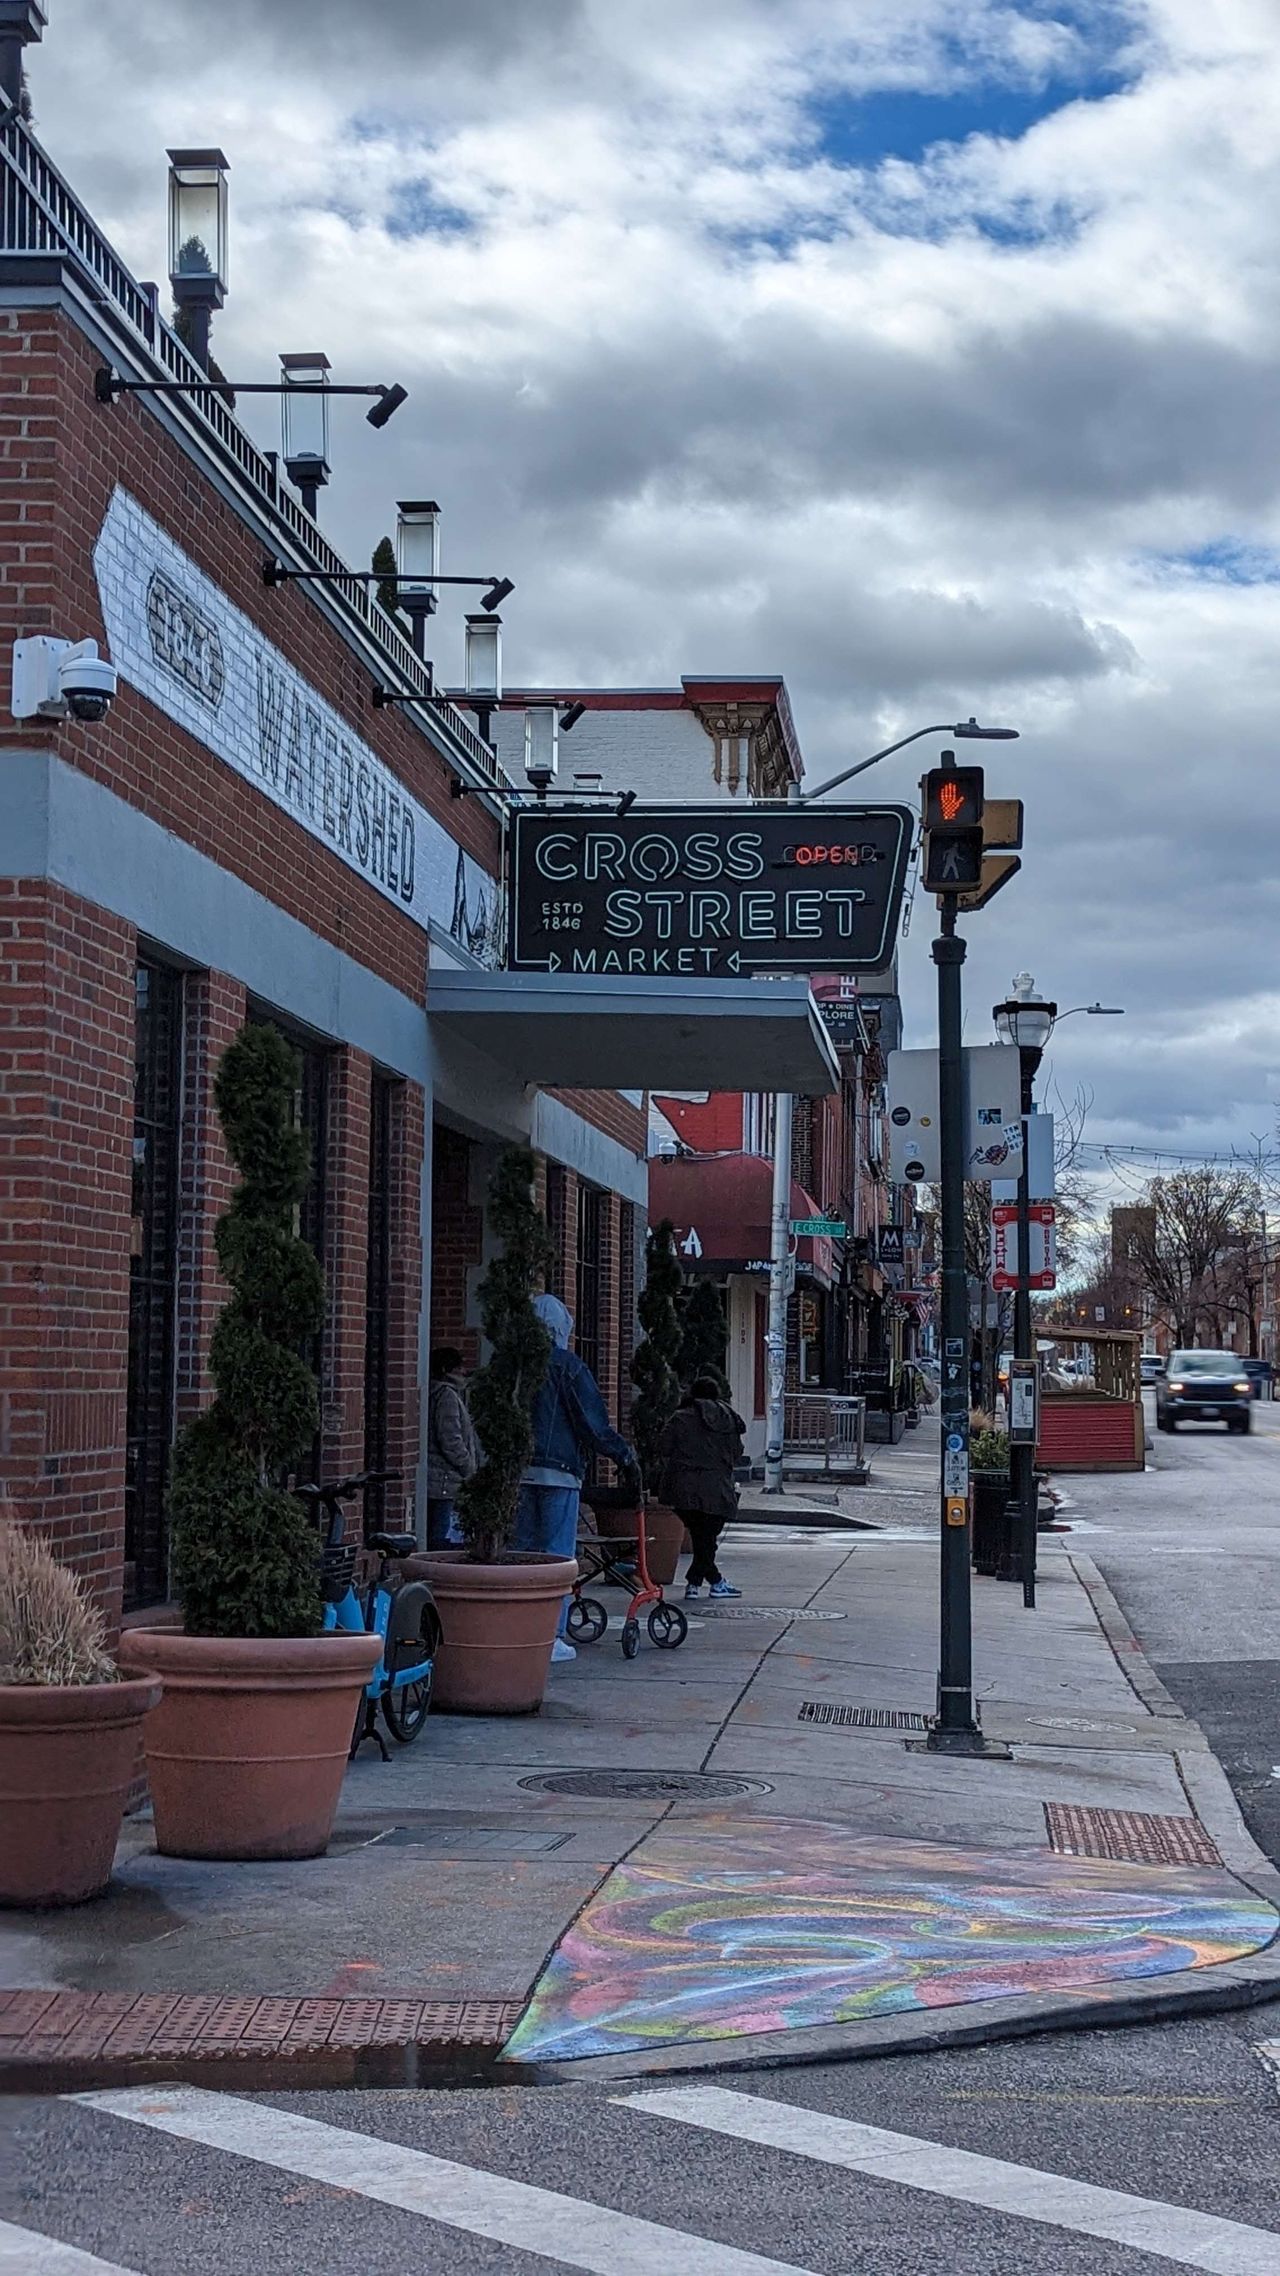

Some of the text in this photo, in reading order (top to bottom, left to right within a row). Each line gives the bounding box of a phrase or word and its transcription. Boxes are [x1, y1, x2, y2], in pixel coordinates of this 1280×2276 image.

[164, 597, 212, 688] 1846
[254, 650, 416, 904] WATERSHED
[535, 833, 765, 881] CROSS
[542, 902, 584, 915] ESTD
[604, 890, 866, 938] STREET
[542, 917, 581, 931] 1846
[572, 947, 719, 972] MARKET
[835, 1003, 855, 1011] DINE
[795, 1223, 801, 1234] E
[803, 1223, 832, 1235] CROSS
[882, 1230, 900, 1247] M
